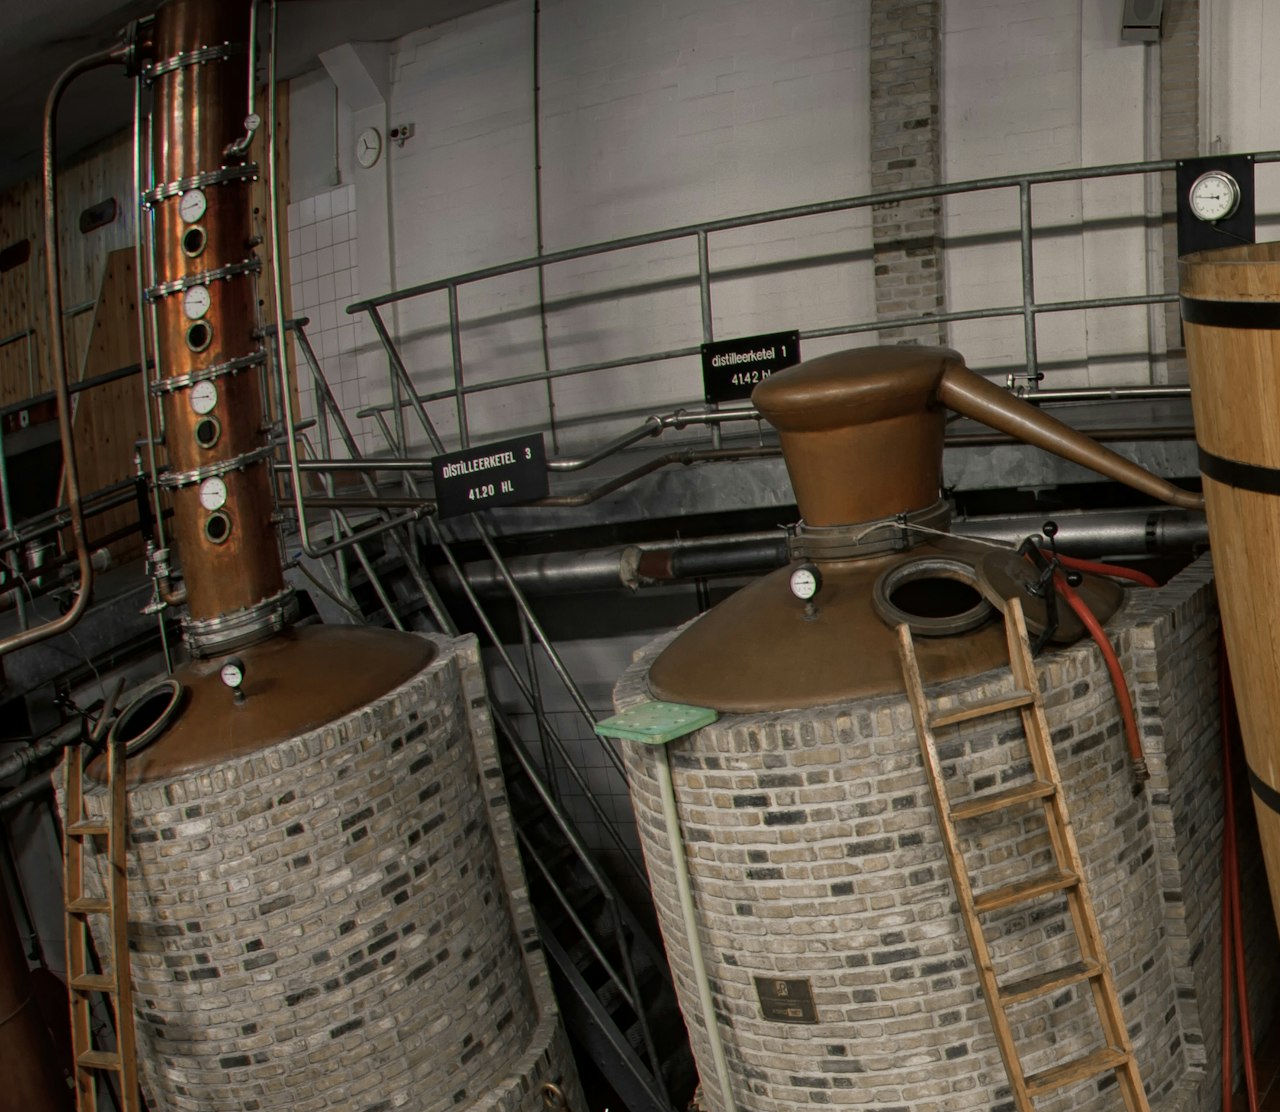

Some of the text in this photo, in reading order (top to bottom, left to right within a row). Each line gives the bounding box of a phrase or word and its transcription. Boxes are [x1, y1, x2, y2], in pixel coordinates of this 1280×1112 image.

[712, 345, 787, 367] distilleerketel 1
[525, 447, 532, 460] 3
[468, 480, 515, 501] 41.20 HL
